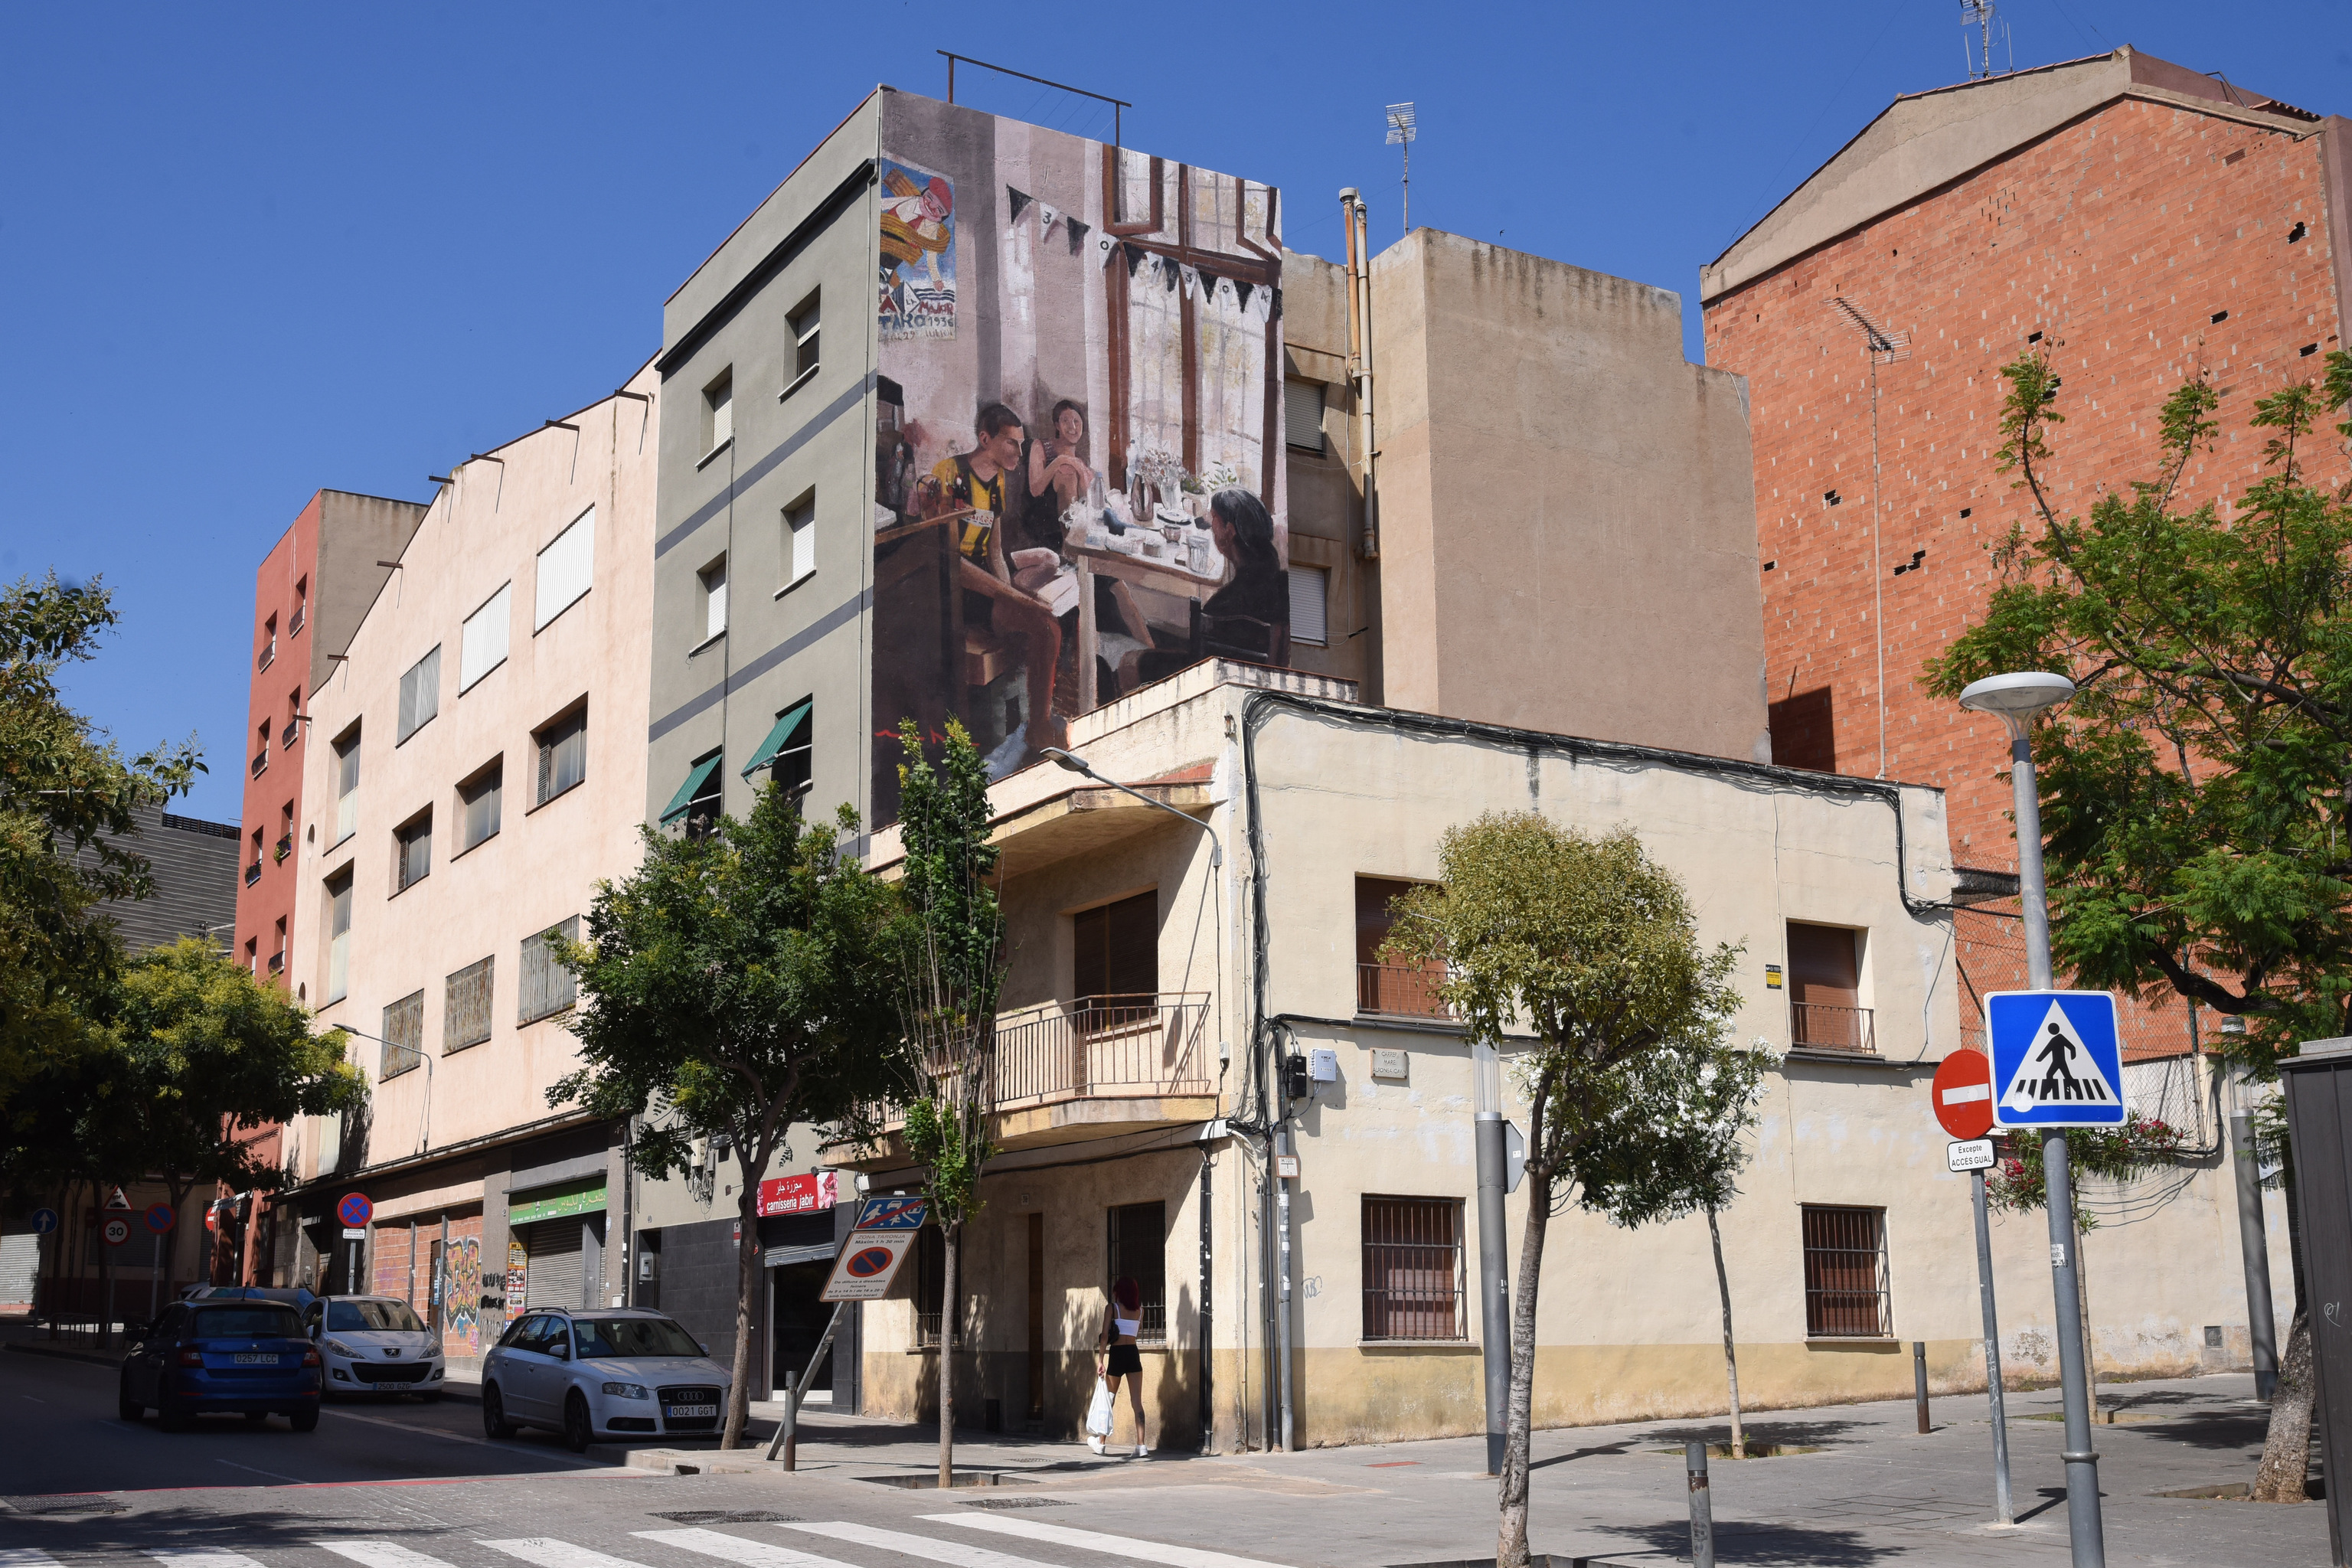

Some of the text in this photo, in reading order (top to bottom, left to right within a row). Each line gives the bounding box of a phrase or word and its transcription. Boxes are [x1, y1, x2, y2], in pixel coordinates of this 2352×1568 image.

[927, 316, 954, 328] 1936
[1958, 1145, 1982, 1154] Excepte
[1952, 1155, 1992, 1167] ACCÉS GUAL
[766, 1194, 815, 1212] carnisseria jabir
[109, 1227, 124, 1236] 30
[237, 1354, 276, 1363] 0257 LCC
[673, 1406, 714, 1416] 0021 GGT
